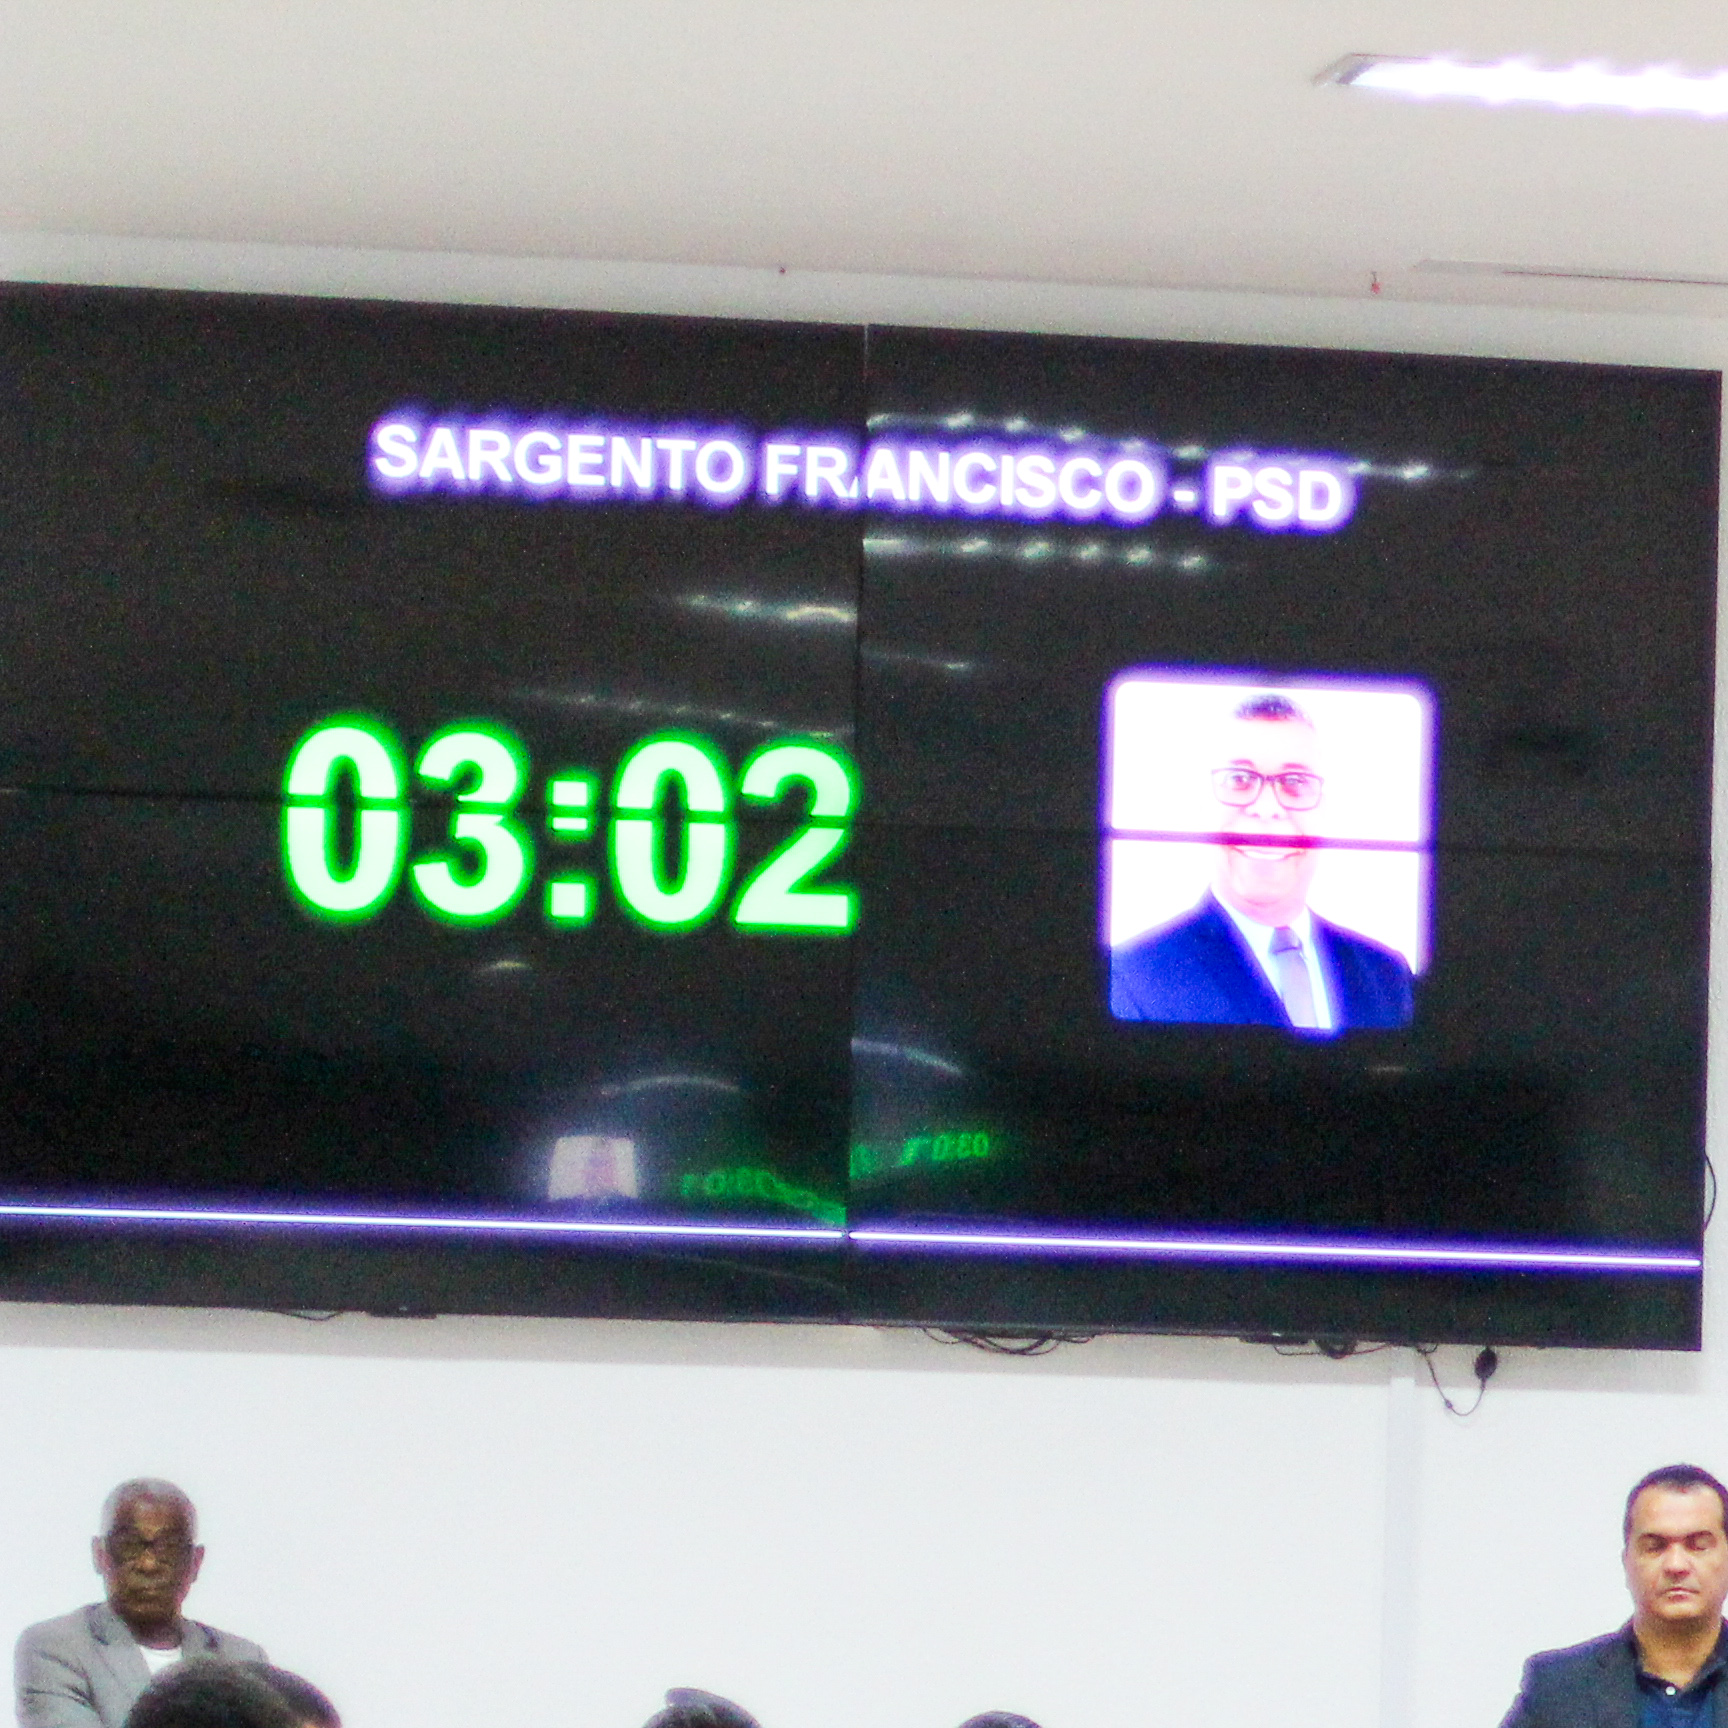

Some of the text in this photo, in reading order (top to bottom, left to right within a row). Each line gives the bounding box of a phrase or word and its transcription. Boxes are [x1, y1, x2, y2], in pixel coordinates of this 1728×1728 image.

[373, 422, 746, 493] SARGENTO
[765, 443, 1156, 514] FRANCISCO
[1213, 465, 1343, 522] PSD
[286, 726, 852, 928] 03:02
